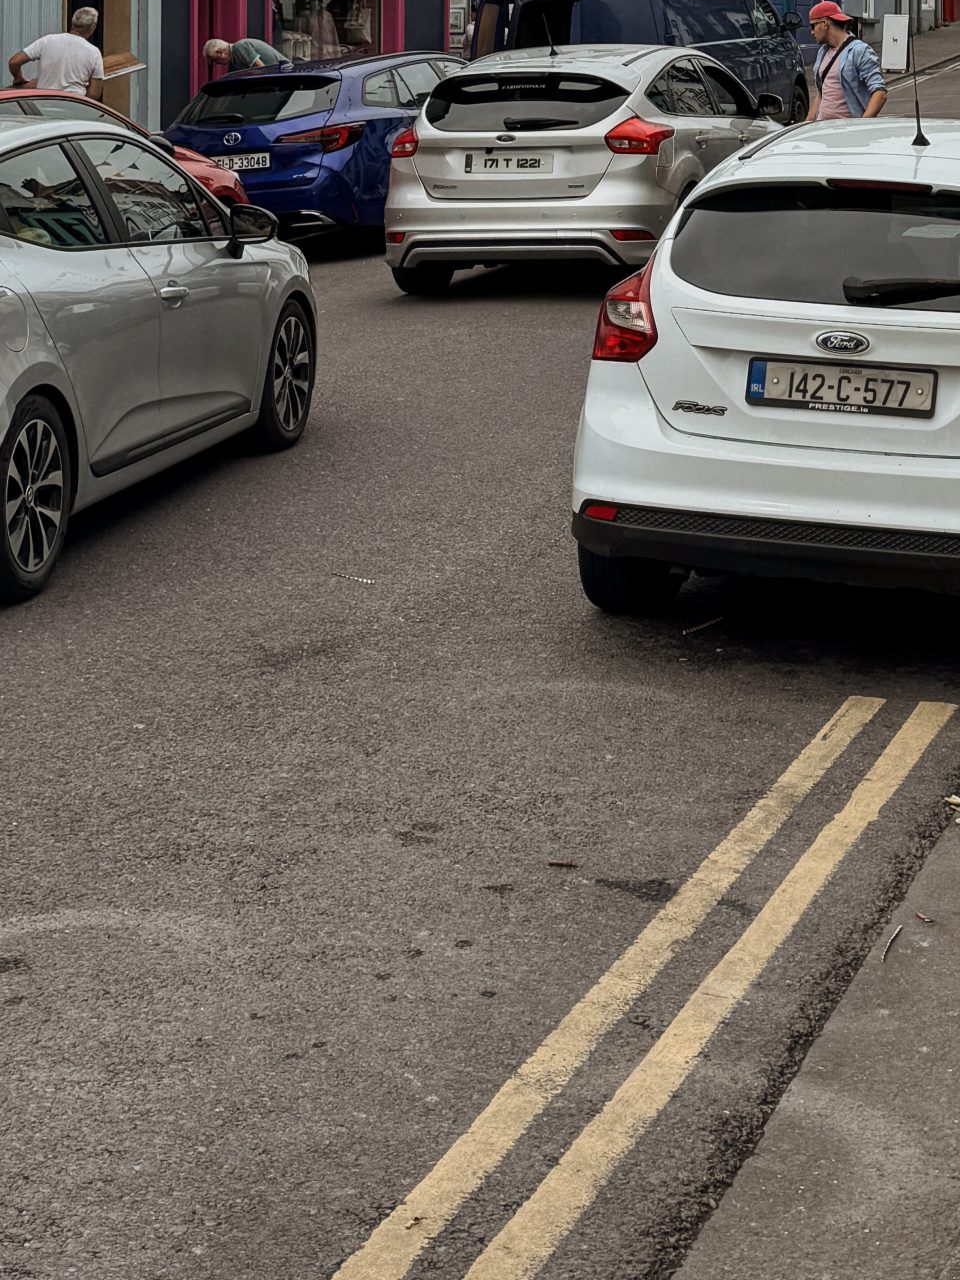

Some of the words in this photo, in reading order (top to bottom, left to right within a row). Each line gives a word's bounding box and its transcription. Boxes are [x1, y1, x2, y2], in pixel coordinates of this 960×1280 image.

[216, 156, 267, 170] 61-D-33048
[484, 158, 499, 169] 171
[503, 158, 512, 169] T
[516, 158, 541, 169] 1221
[827, 334, 856, 349] Ford
[751, 383, 764, 393] IRL
[788, 371, 911, 407] 142-C-577
